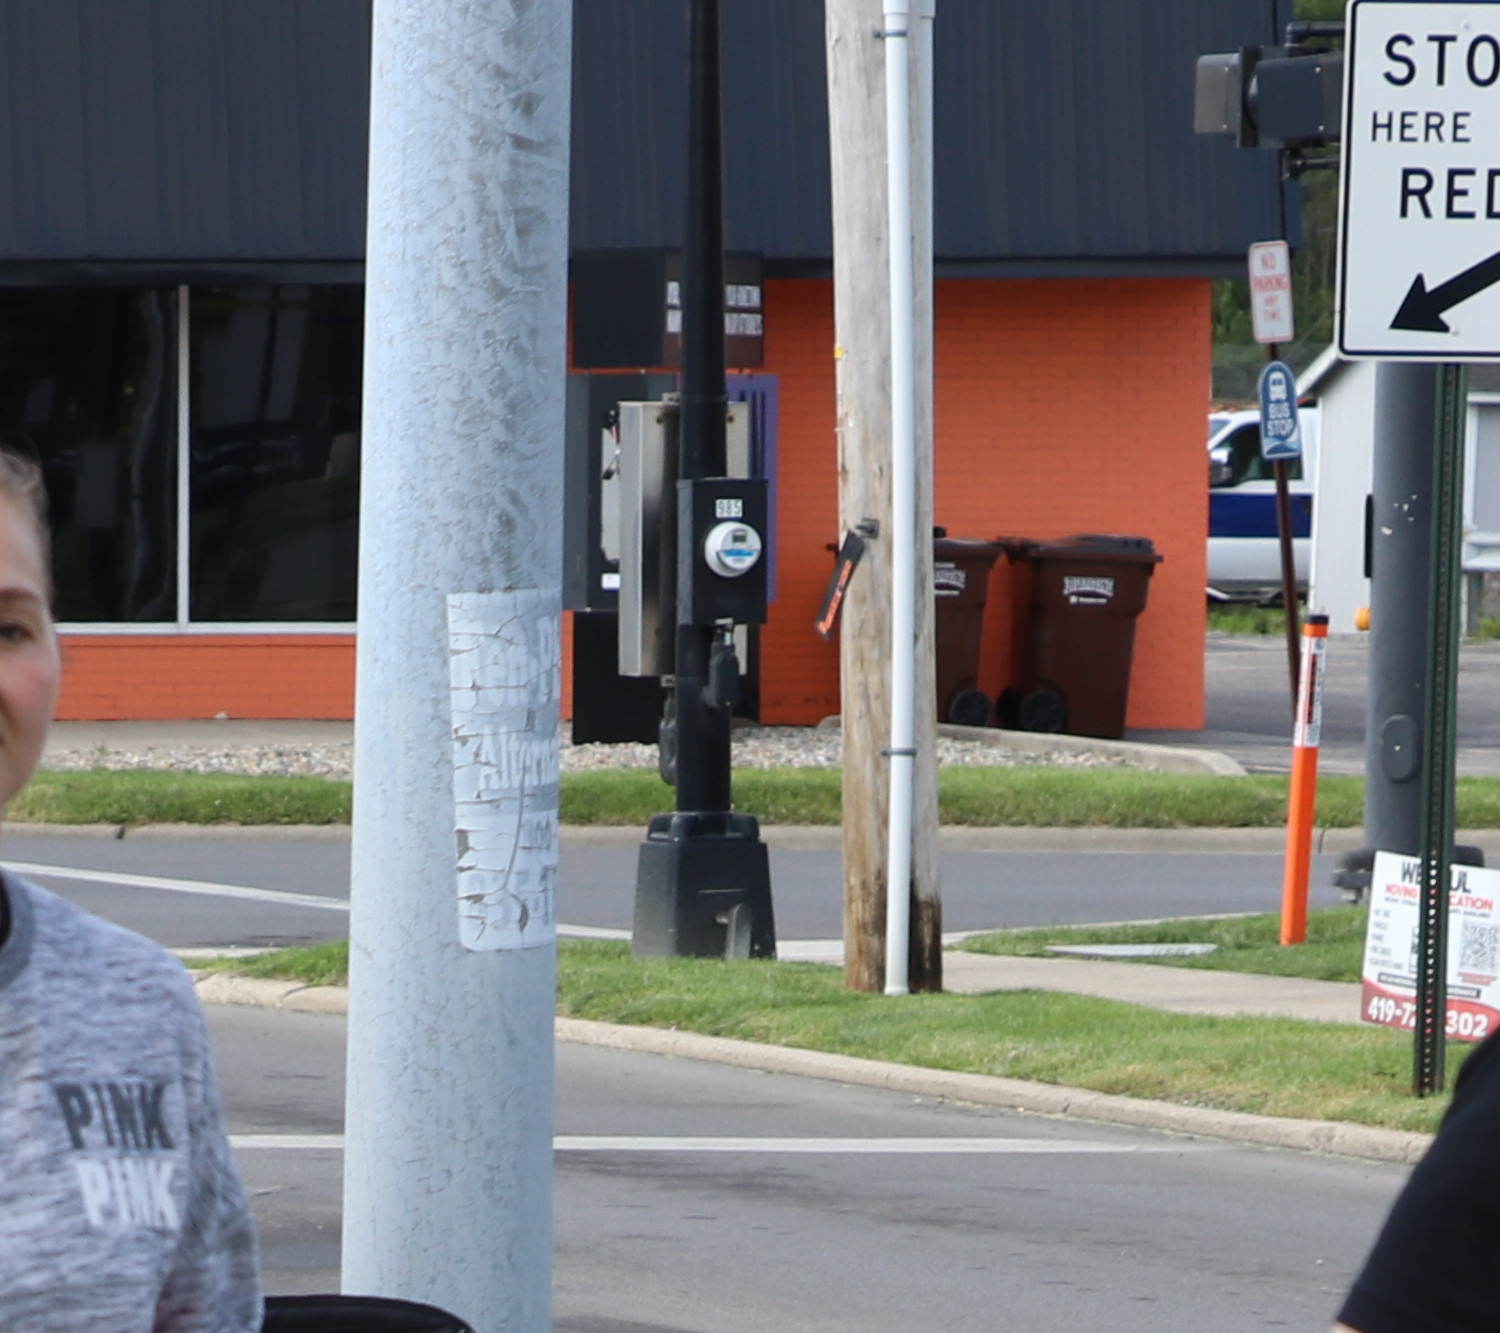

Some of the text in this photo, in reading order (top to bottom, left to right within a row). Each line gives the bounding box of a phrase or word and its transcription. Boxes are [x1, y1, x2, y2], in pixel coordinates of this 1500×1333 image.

[1371, 111, 1471, 142] HERE
[1269, 403, 1291, 419] BUS
[1267, 420, 1293, 437] STOP
[1449, 894, 1493, 911] CATION
[54, 1082, 176, 1150] PINK
[76, 1159, 181, 1229] PINK
